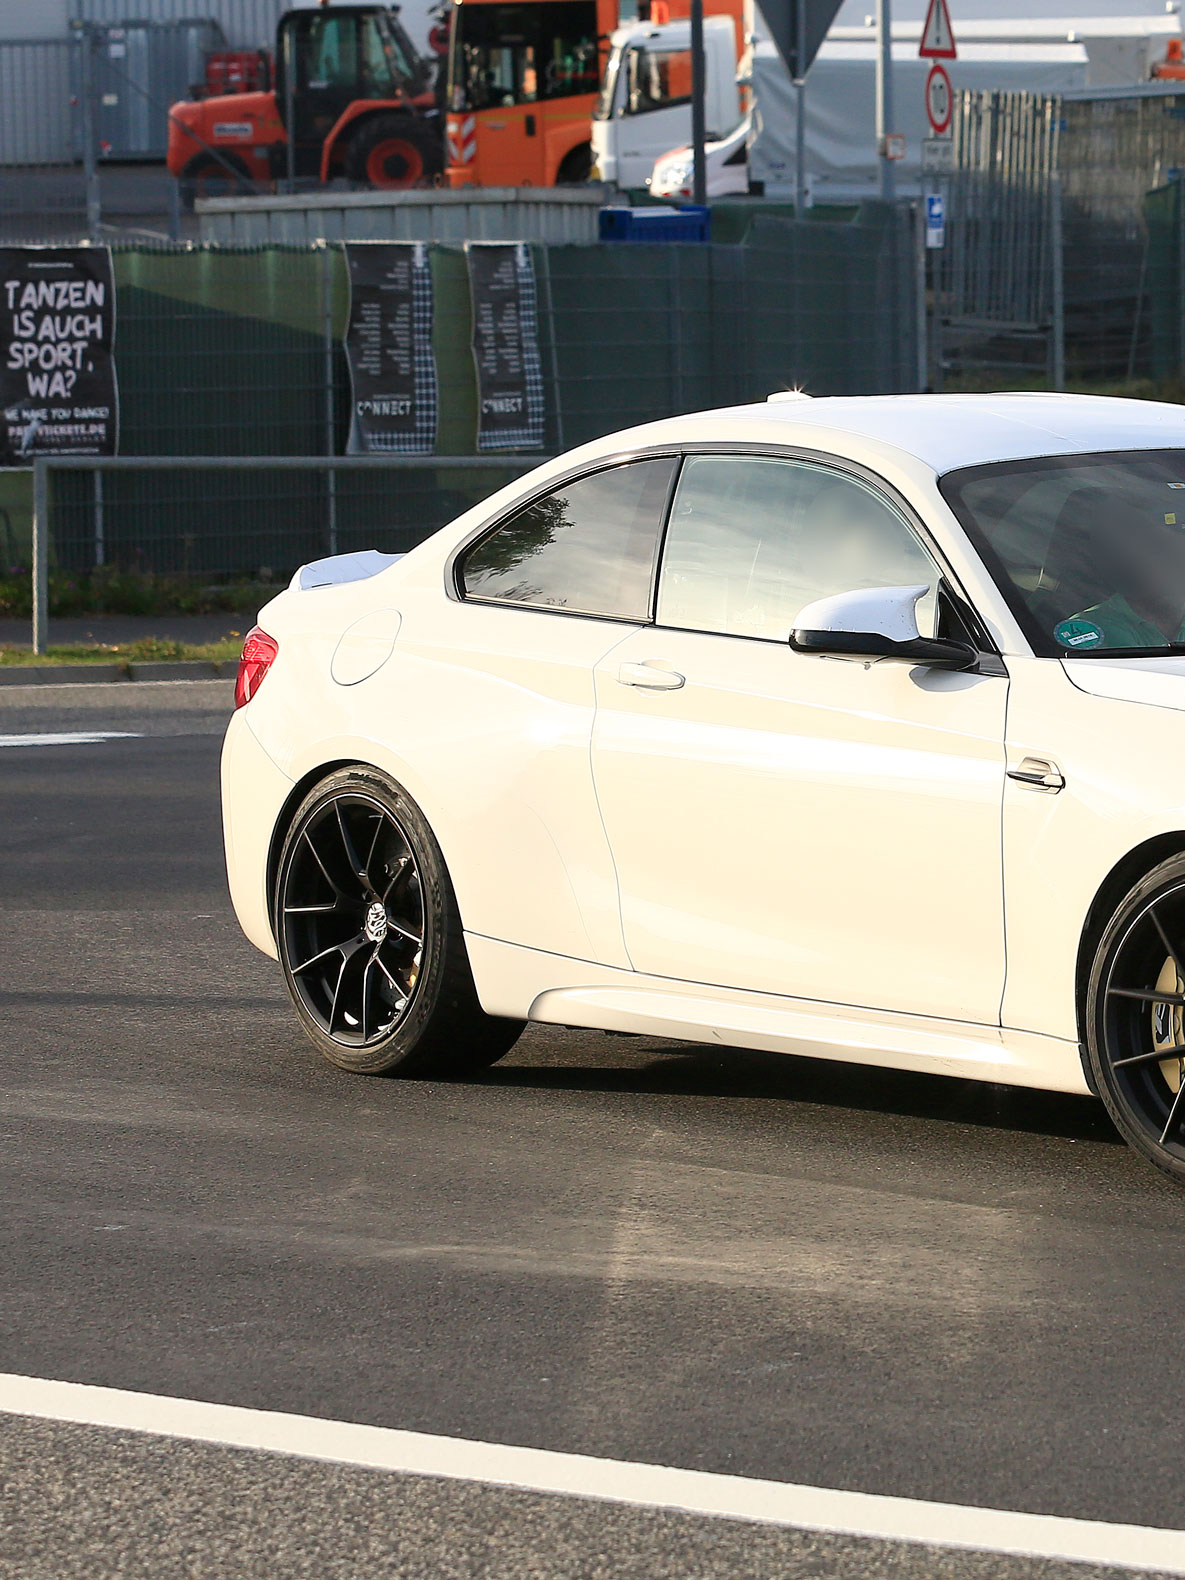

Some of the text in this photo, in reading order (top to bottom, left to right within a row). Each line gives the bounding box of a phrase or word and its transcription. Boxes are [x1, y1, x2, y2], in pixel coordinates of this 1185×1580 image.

[4, 280, 105, 310] TANZEN
[13, 309, 103, 341] IS AUCH
[27, 369, 77, 398] WA?
[4, 408, 19, 421] WE
[51, 407, 72, 420] YOU
[357, 400, 411, 416] CONNECT
[482, 398, 522, 414] CONNECT
[8, 423, 106, 436] PARYTICKETS.DE
